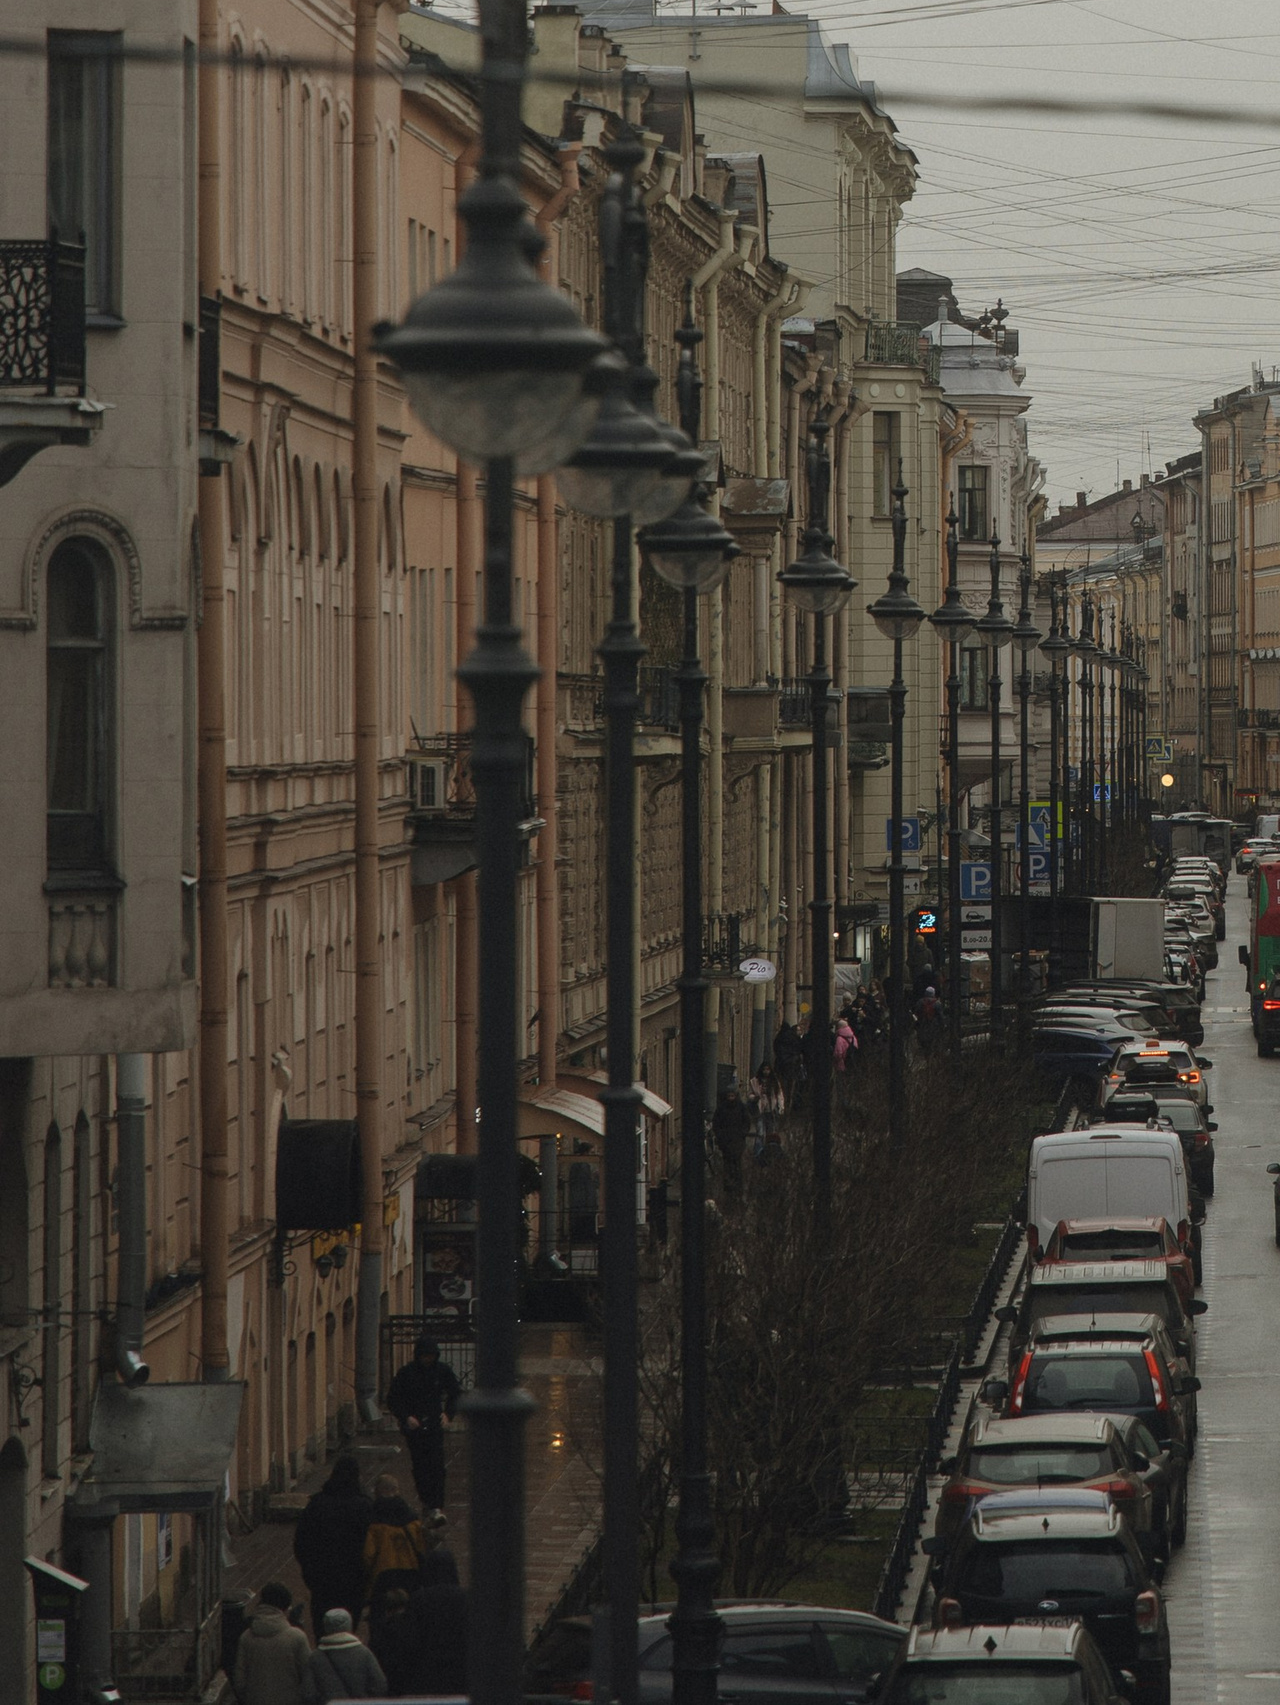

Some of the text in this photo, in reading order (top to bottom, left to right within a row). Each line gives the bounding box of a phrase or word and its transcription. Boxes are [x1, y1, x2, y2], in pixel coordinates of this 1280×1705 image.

[1029, 854, 1046, 879] P
[970, 866, 992, 896] P
[749, 962, 767, 973] Pio
[46, 1666, 61, 1684] P
